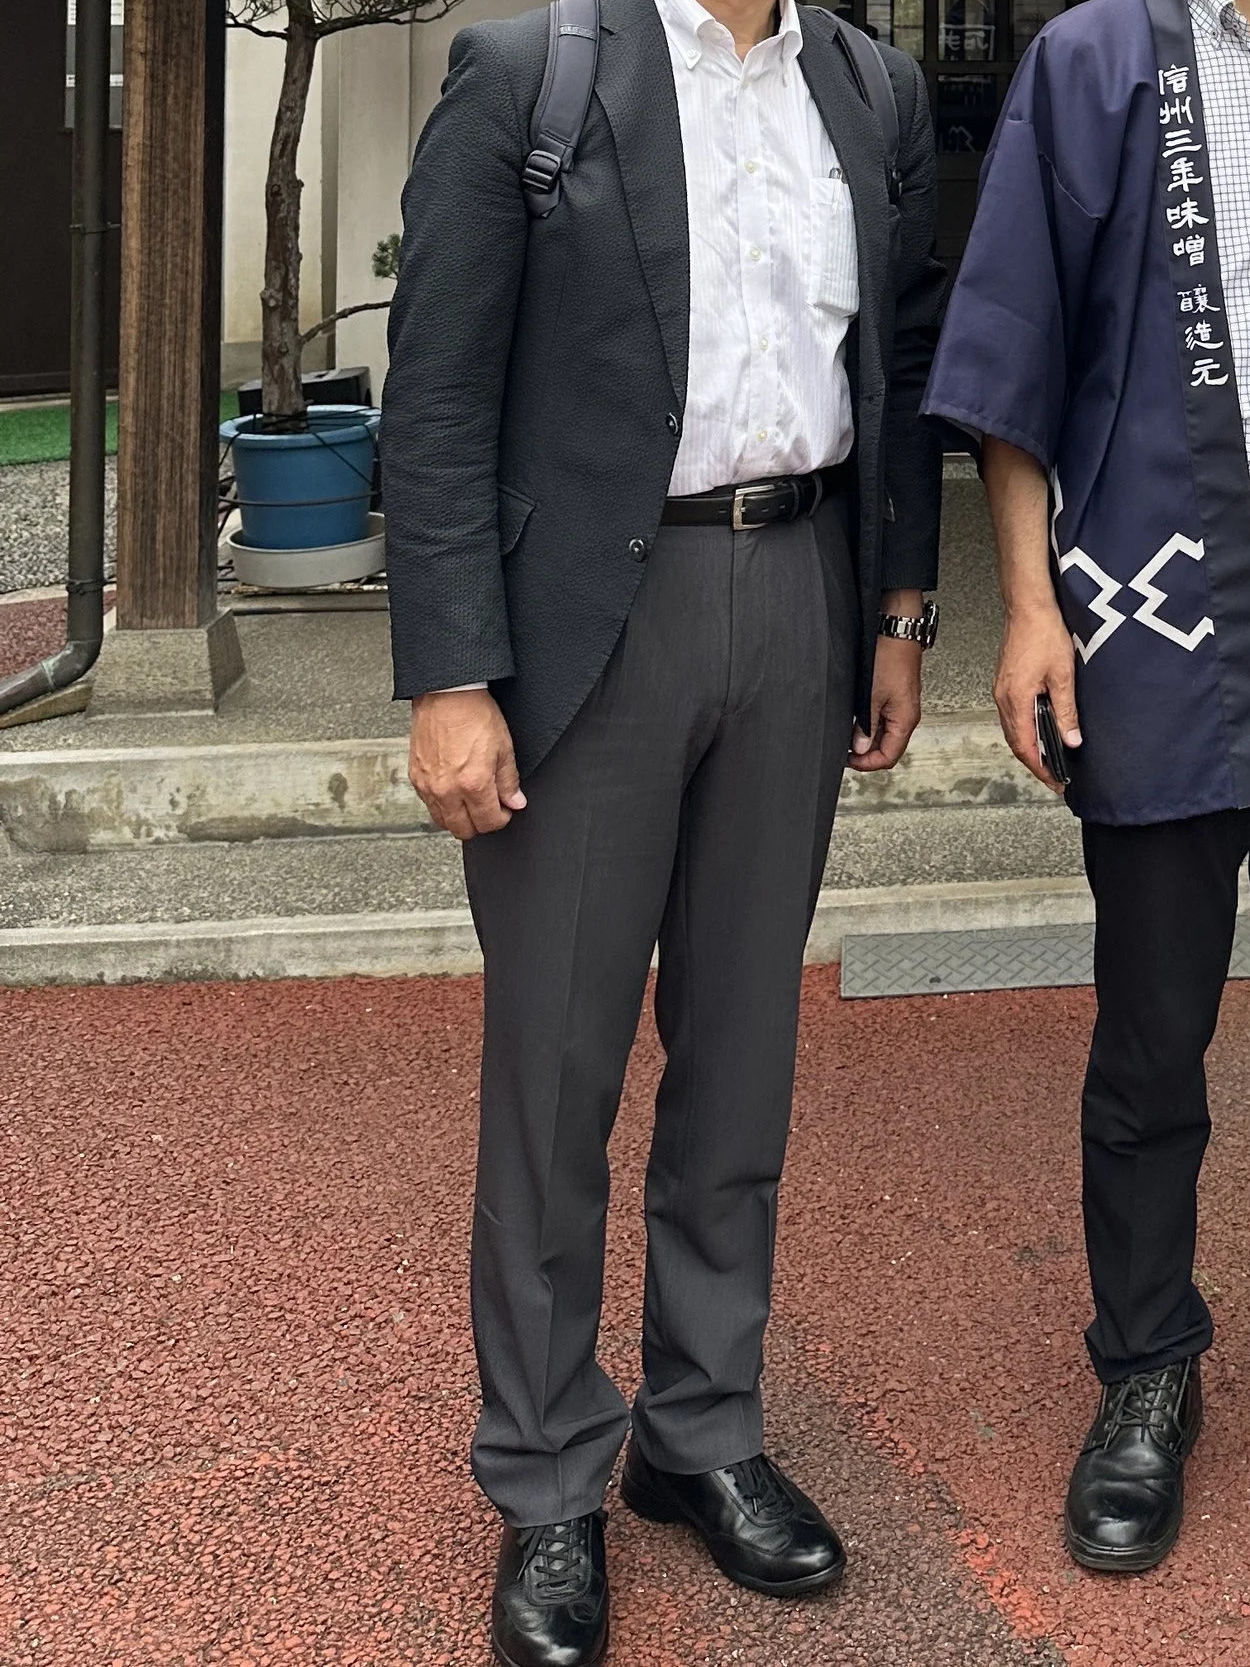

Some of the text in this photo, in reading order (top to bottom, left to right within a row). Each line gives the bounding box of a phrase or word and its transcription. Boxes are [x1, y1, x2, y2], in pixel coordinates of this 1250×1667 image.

[1157, 64, 1209, 266] 信州三年味噌
